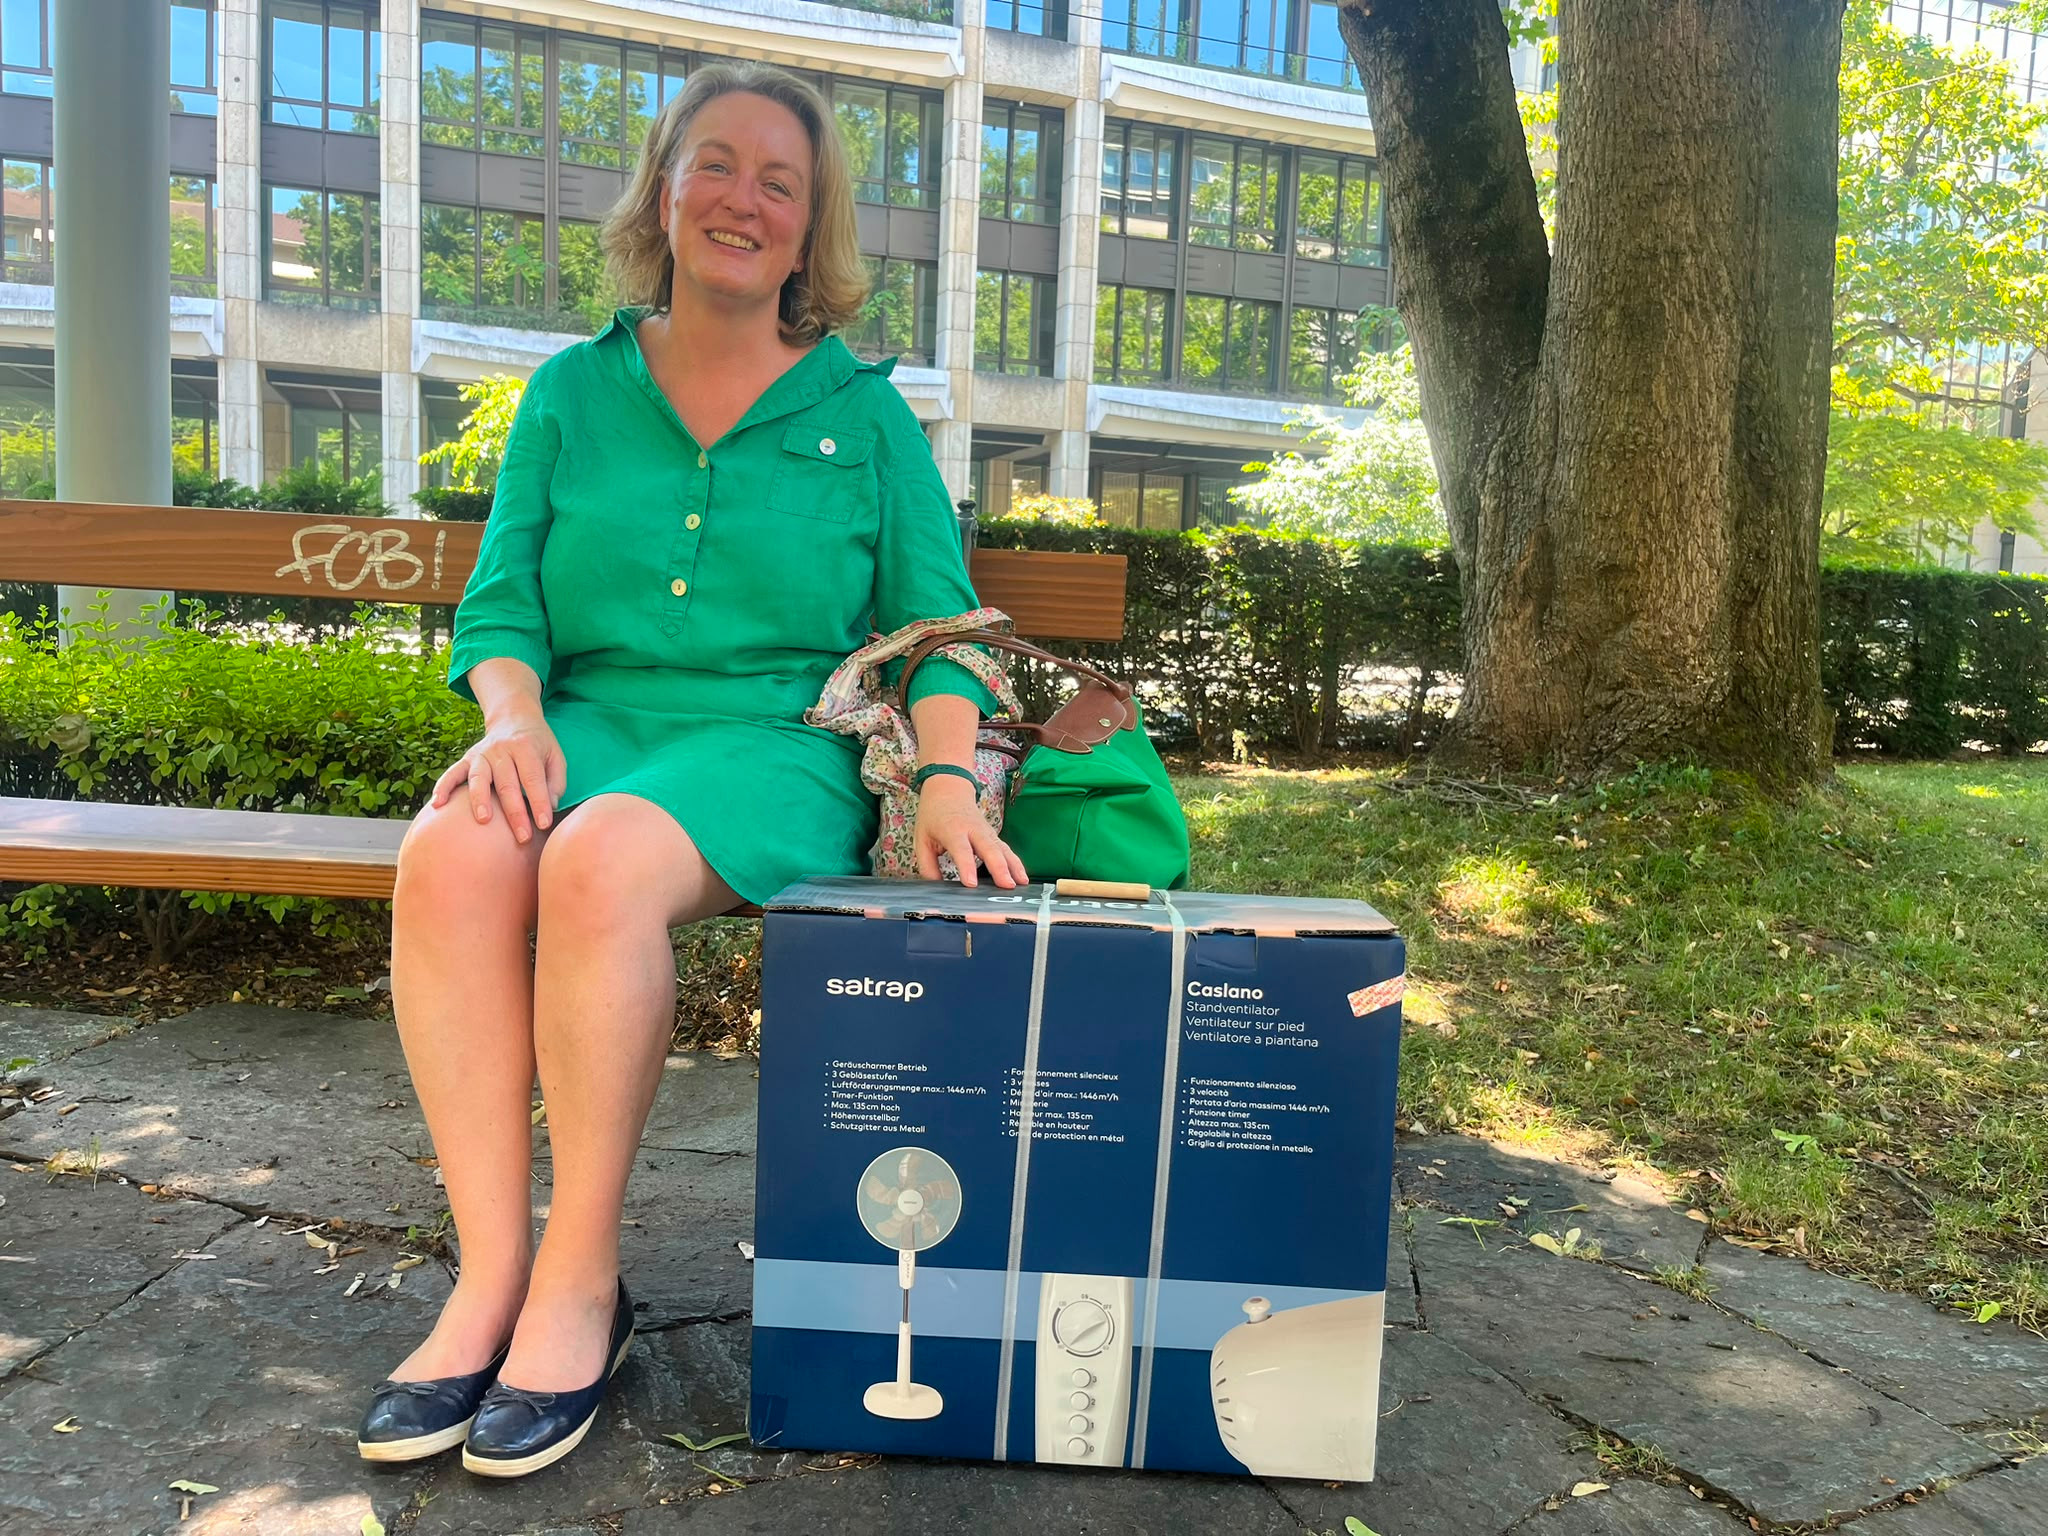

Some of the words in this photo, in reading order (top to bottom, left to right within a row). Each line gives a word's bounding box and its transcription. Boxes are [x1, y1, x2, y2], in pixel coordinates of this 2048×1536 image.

[826, 976, 924, 1002] satrap
[1187, 981, 1263, 1000] Caslano
[1186, 1001, 1280, 1016] Standventilator
[1186, 1016, 1252, 1029] Ventilateur
[1255, 1020, 1274, 1030] sur
[1277, 1021, 1305, 1033] pied
[1185, 1030, 1251, 1044] Ventilatore
[1254, 1036, 1262, 1044] a
[1265, 1036, 1319, 1048] piantana
[832, 1060, 895, 1070] Geräuscharmer
[897, 1062, 927, 1071] Betrieb
[838, 1070, 897, 1080] Gebläsestufen
[1010, 1067, 1077, 1079] Fononnement
[1079, 1071, 1118, 1080] silencieux
[831, 1080, 920, 1092] Luftförderungsmenge
[1010, 1077, 1015, 1085] 3
[1190, 1077, 1254, 1087] Funzionamento
[1256, 1081, 1296, 1090] silenzioso
[831, 1090, 893, 1100] Timer-Funktion
[1034, 1087, 1053, 1097] d'air
[1196, 1088, 1228, 1096] velocità
[830, 1100, 850, 1108] Max.
[880, 1103, 900, 1111] hoch
[1189, 1097, 1221, 1106] Portata
[1223, 1099, 1247, 1108] d'aria
[1248, 1102, 1286, 1110] massima
[1288, 1103, 1307, 1111] 1446
[830, 1111, 899, 1121] Höhenverstellbar
[1009, 1109, 1044, 1118] Haur
[1188, 1107, 1225, 1117] Funzione
[1227, 1110, 1250, 1118] timer
[830, 1121, 881, 1131] Schutzgitter
[899, 1124, 925, 1132] Metall
[1008, 1118, 1044, 1128] Réble
[1057, 1121, 1089, 1130] hauteur
[1188, 1118, 1219, 1127] Altezza
[1031, 1130, 1043, 1138] de
[1043, 1132, 1086, 1140] protection
[1099, 1134, 1123, 1142] métal
[1188, 1128, 1230, 1138] Regolabile
[1241, 1131, 1271, 1140] altezza
[1187, 1138, 1214, 1148] Griglia
[1226, 1142, 1270, 1150] protezione
[1281, 1145, 1313, 1153] metallo
